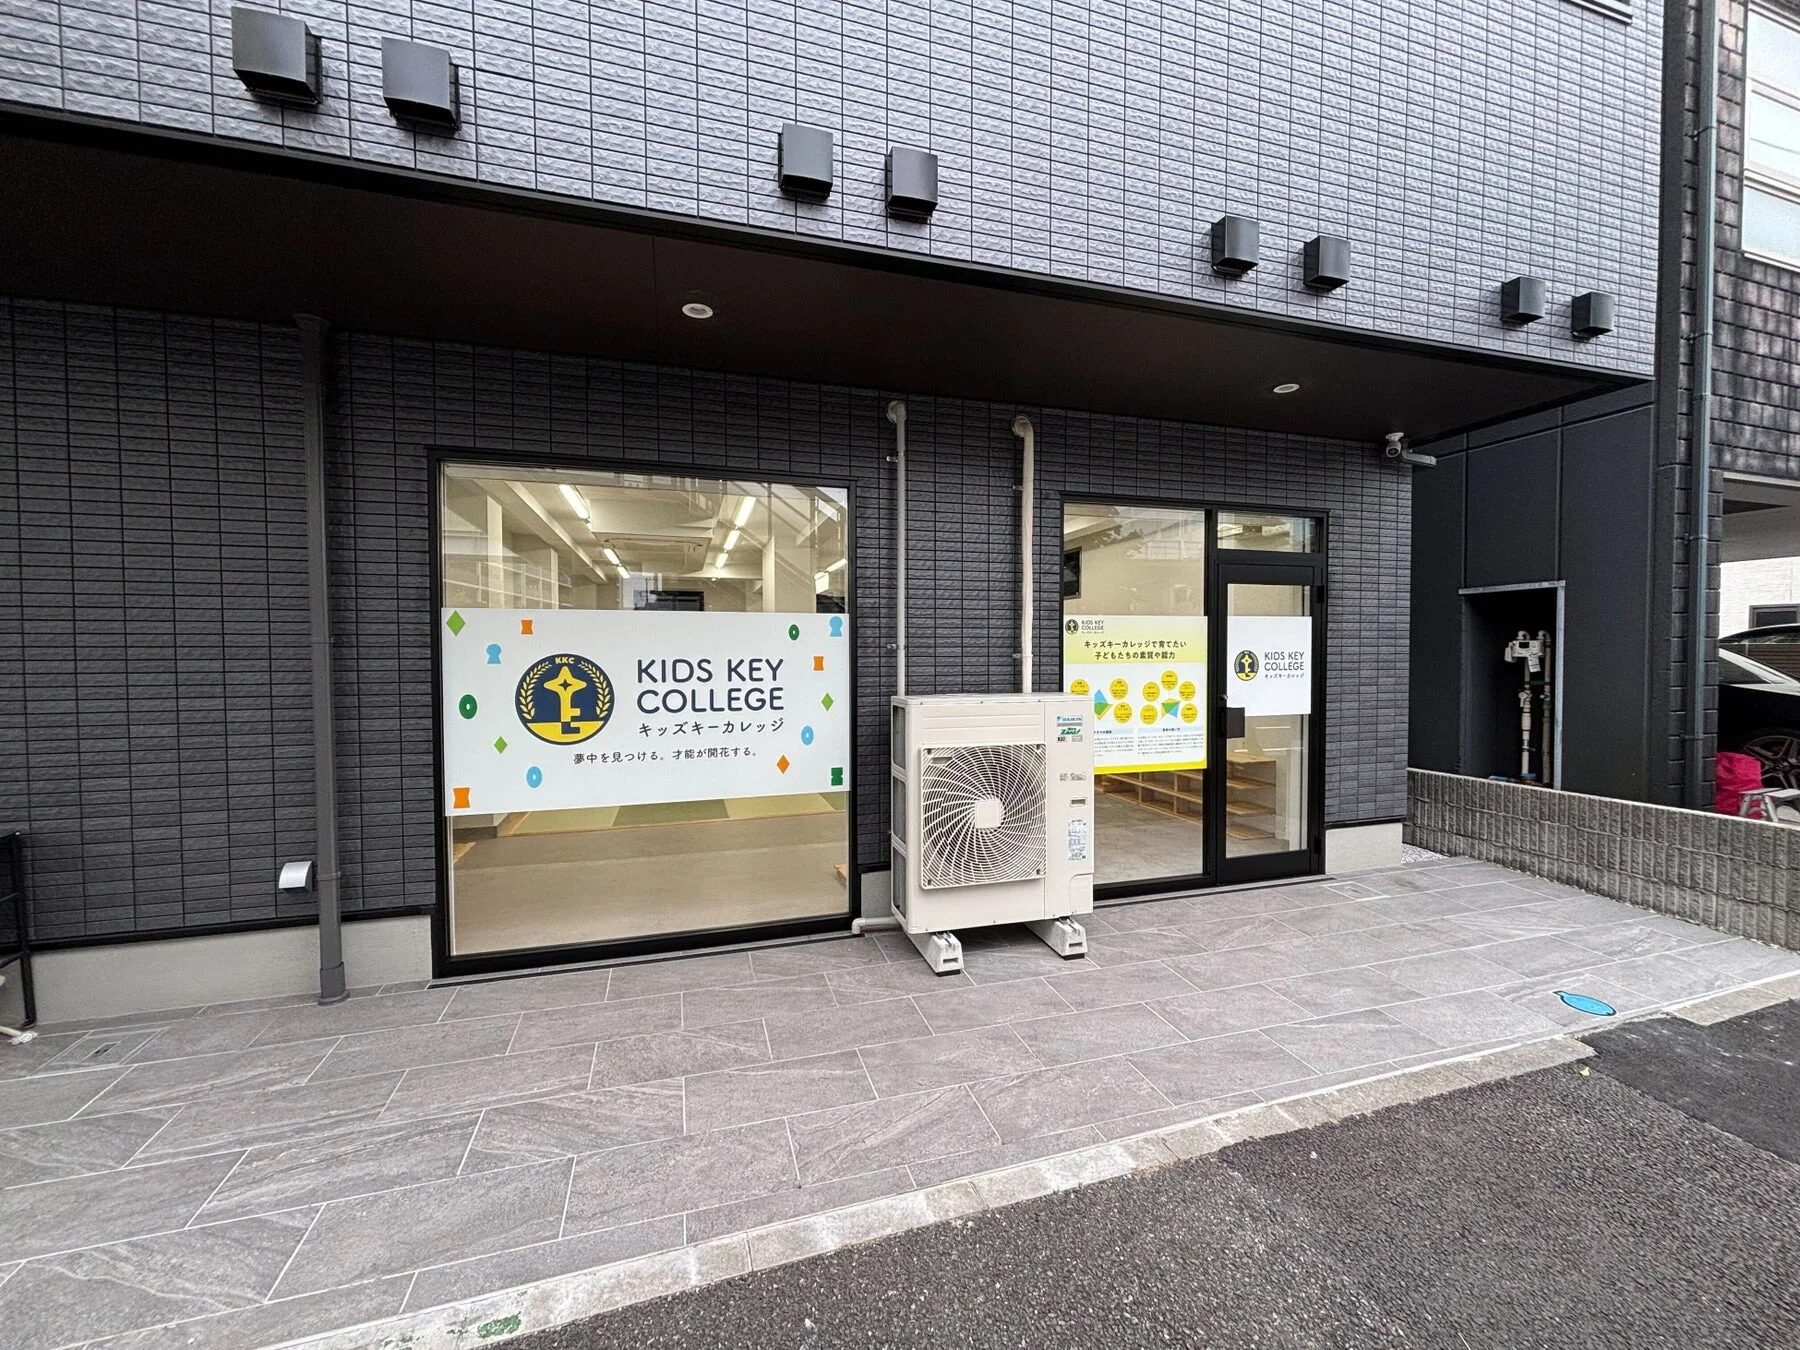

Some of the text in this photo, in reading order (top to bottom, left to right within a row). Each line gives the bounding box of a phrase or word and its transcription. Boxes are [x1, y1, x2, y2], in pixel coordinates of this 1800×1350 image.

[1084, 639, 1187, 649] キッズキーカレッジで育てたい
[555, 656, 575, 665] KKC
[1094, 650, 1176, 661] 子どもたちの素質や能力
[1264, 651, 1304, 660] KIDS KEY
[637, 658, 784, 684] KIDS KEY
[1264, 662, 1304, 671] COLLEGE
[636, 686, 785, 714] COLLEGE
[638, 717, 784, 738] キッズキーカレッジ
